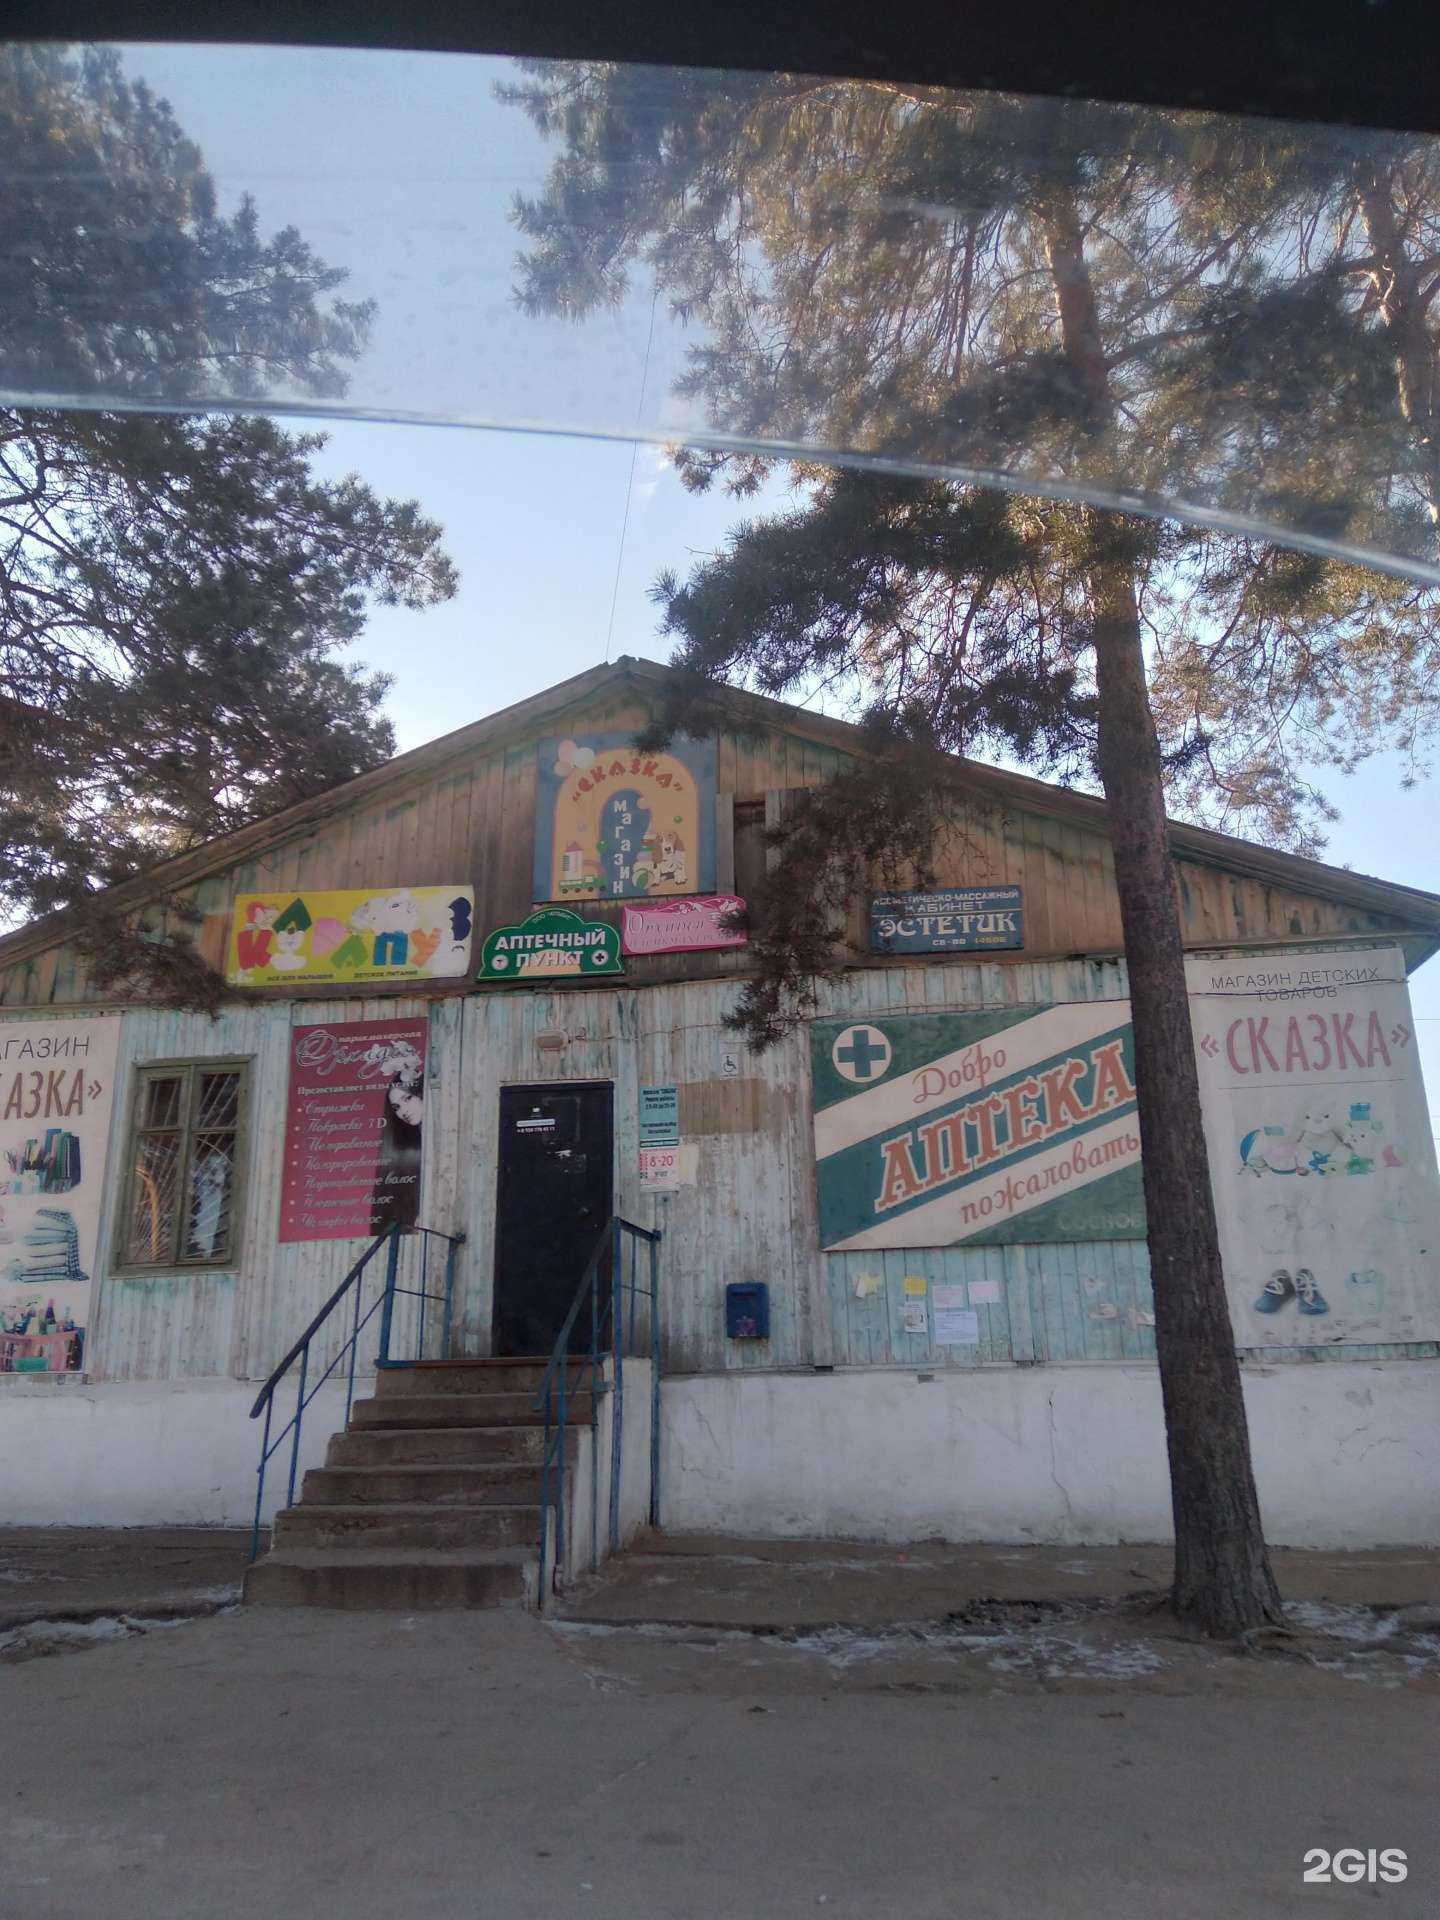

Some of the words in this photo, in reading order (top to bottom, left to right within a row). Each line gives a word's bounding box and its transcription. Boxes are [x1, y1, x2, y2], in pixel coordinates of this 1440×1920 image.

[494, 928, 606, 951] АПТЕЧНЫЙ
[516, 951, 585, 968] ПУНКТ
[1211, 973, 1291, 989] МАГАЗИН
[1299, 967, 1379, 984] ДЕТСКИХ
[1256, 985, 1337, 1001] ТОВАРОВ
[0, 1036, 90, 1060] ГАЗИН
[1200, 1010, 1411, 1074] «СКАЗКА»
[912, 1044, 1006, 1103] Добро
[0, 1068, 103, 1120] АЗКА»
[875, 1040, 1137, 1211] АПТЕКА
[960, 1133, 1139, 1224] пожаловать
